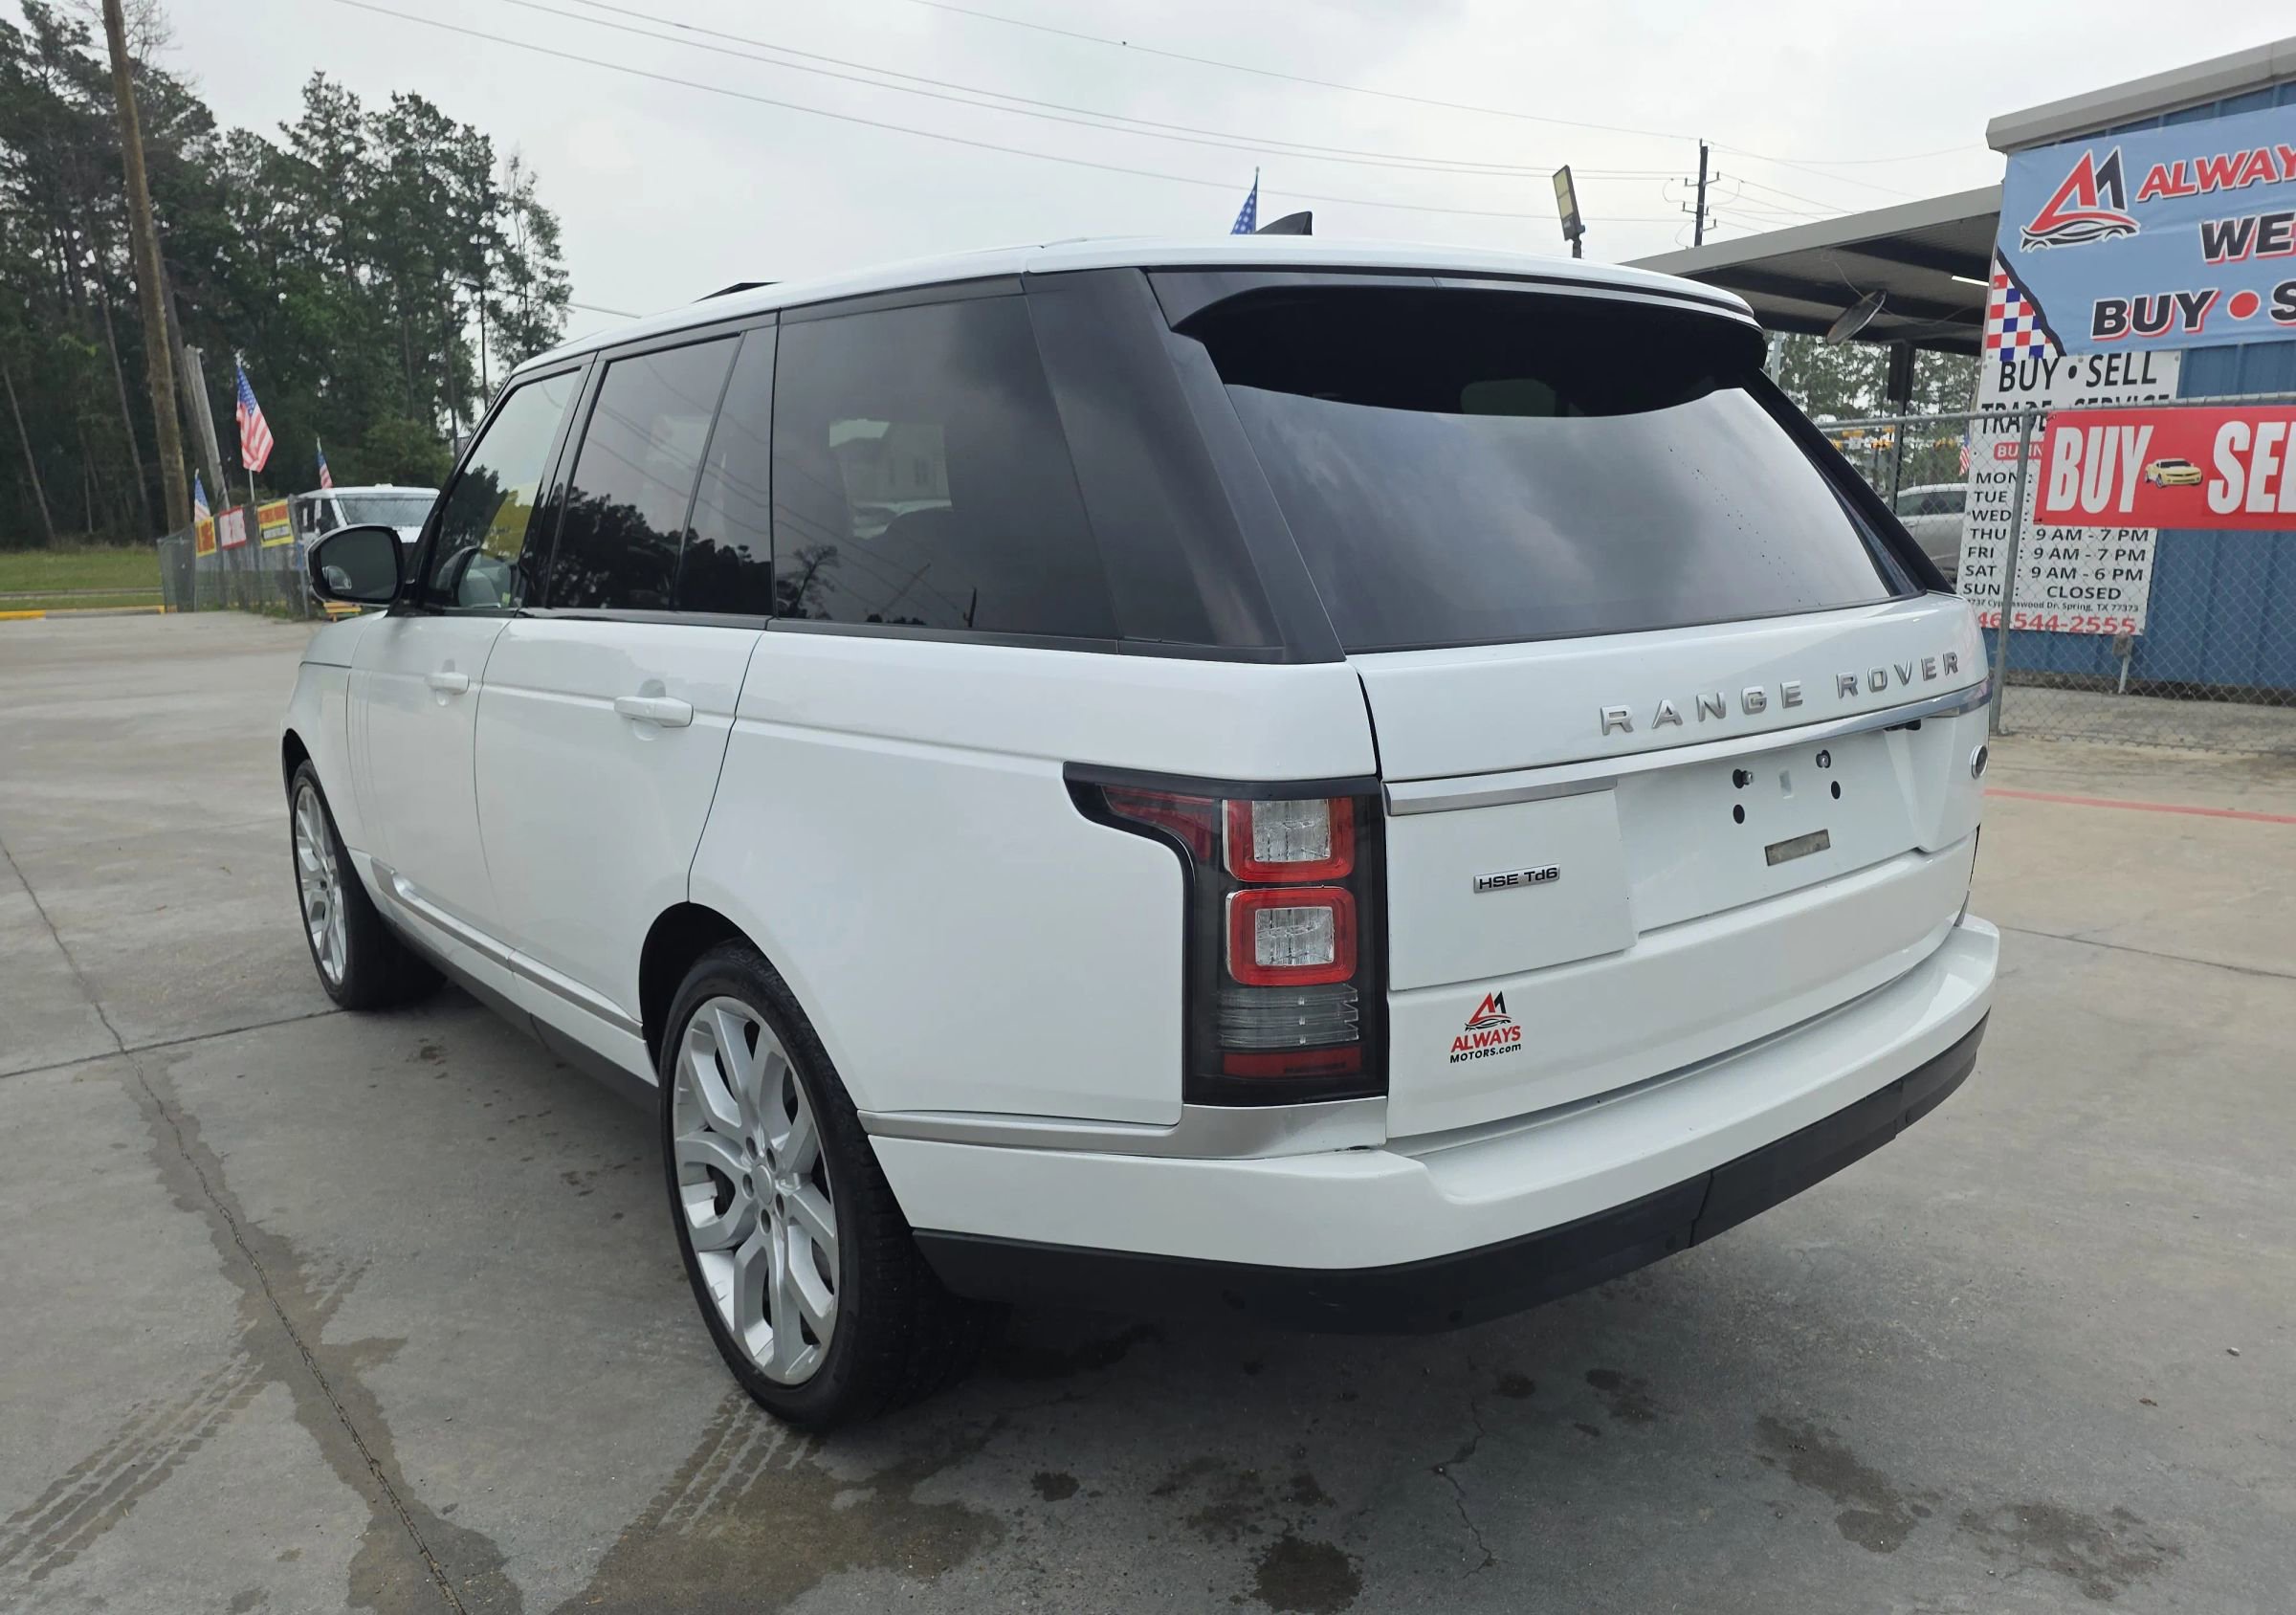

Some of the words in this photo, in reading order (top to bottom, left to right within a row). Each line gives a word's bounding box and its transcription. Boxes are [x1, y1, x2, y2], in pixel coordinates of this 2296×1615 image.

[2199, 210, 2296, 265] WE
[2090, 288, 2221, 342] BUY
[1998, 357, 2061, 392] BUY
[2086, 350, 2157, 387] SELL
[2045, 425, 2154, 514] BUY
[1974, 491, 2008, 503] TUE
[1972, 509, 2012, 521] WED
[1970, 528, 2007, 541] THU
[2036, 528, 2046, 541] 9
[2051, 528, 2083, 542] AM
[2100, 528, 2111, 542] 7
[2117, 529, 2149, 542] PM
[1968, 546, 1995, 559] FRI
[2033, 547, 2044, 560] 9
[2048, 547, 2080, 561] AM
[2097, 548, 2108, 562] 7
[2114, 549, 2147, 562] PM
[1965, 564, 1998, 578] SAT
[2031, 566, 2042, 579] 9
[2045, 566, 2077, 580] AM
[2094, 568, 2106, 581] 6
[2111, 568, 2144, 582] PM
[1963, 583, 2001, 595] SUN
[2046, 586, 2122, 601] CLOSED
[1601, 680, 1803, 736] RANGE
[1835, 652, 1959, 699] ROVER
[1479, 873, 1519, 890] HSE
[1523, 867, 1558, 883] Td6
[1450, 1026, 1521, 1053] ALWAYS
[1449, 1043, 1521, 1064] MOTORS.com
